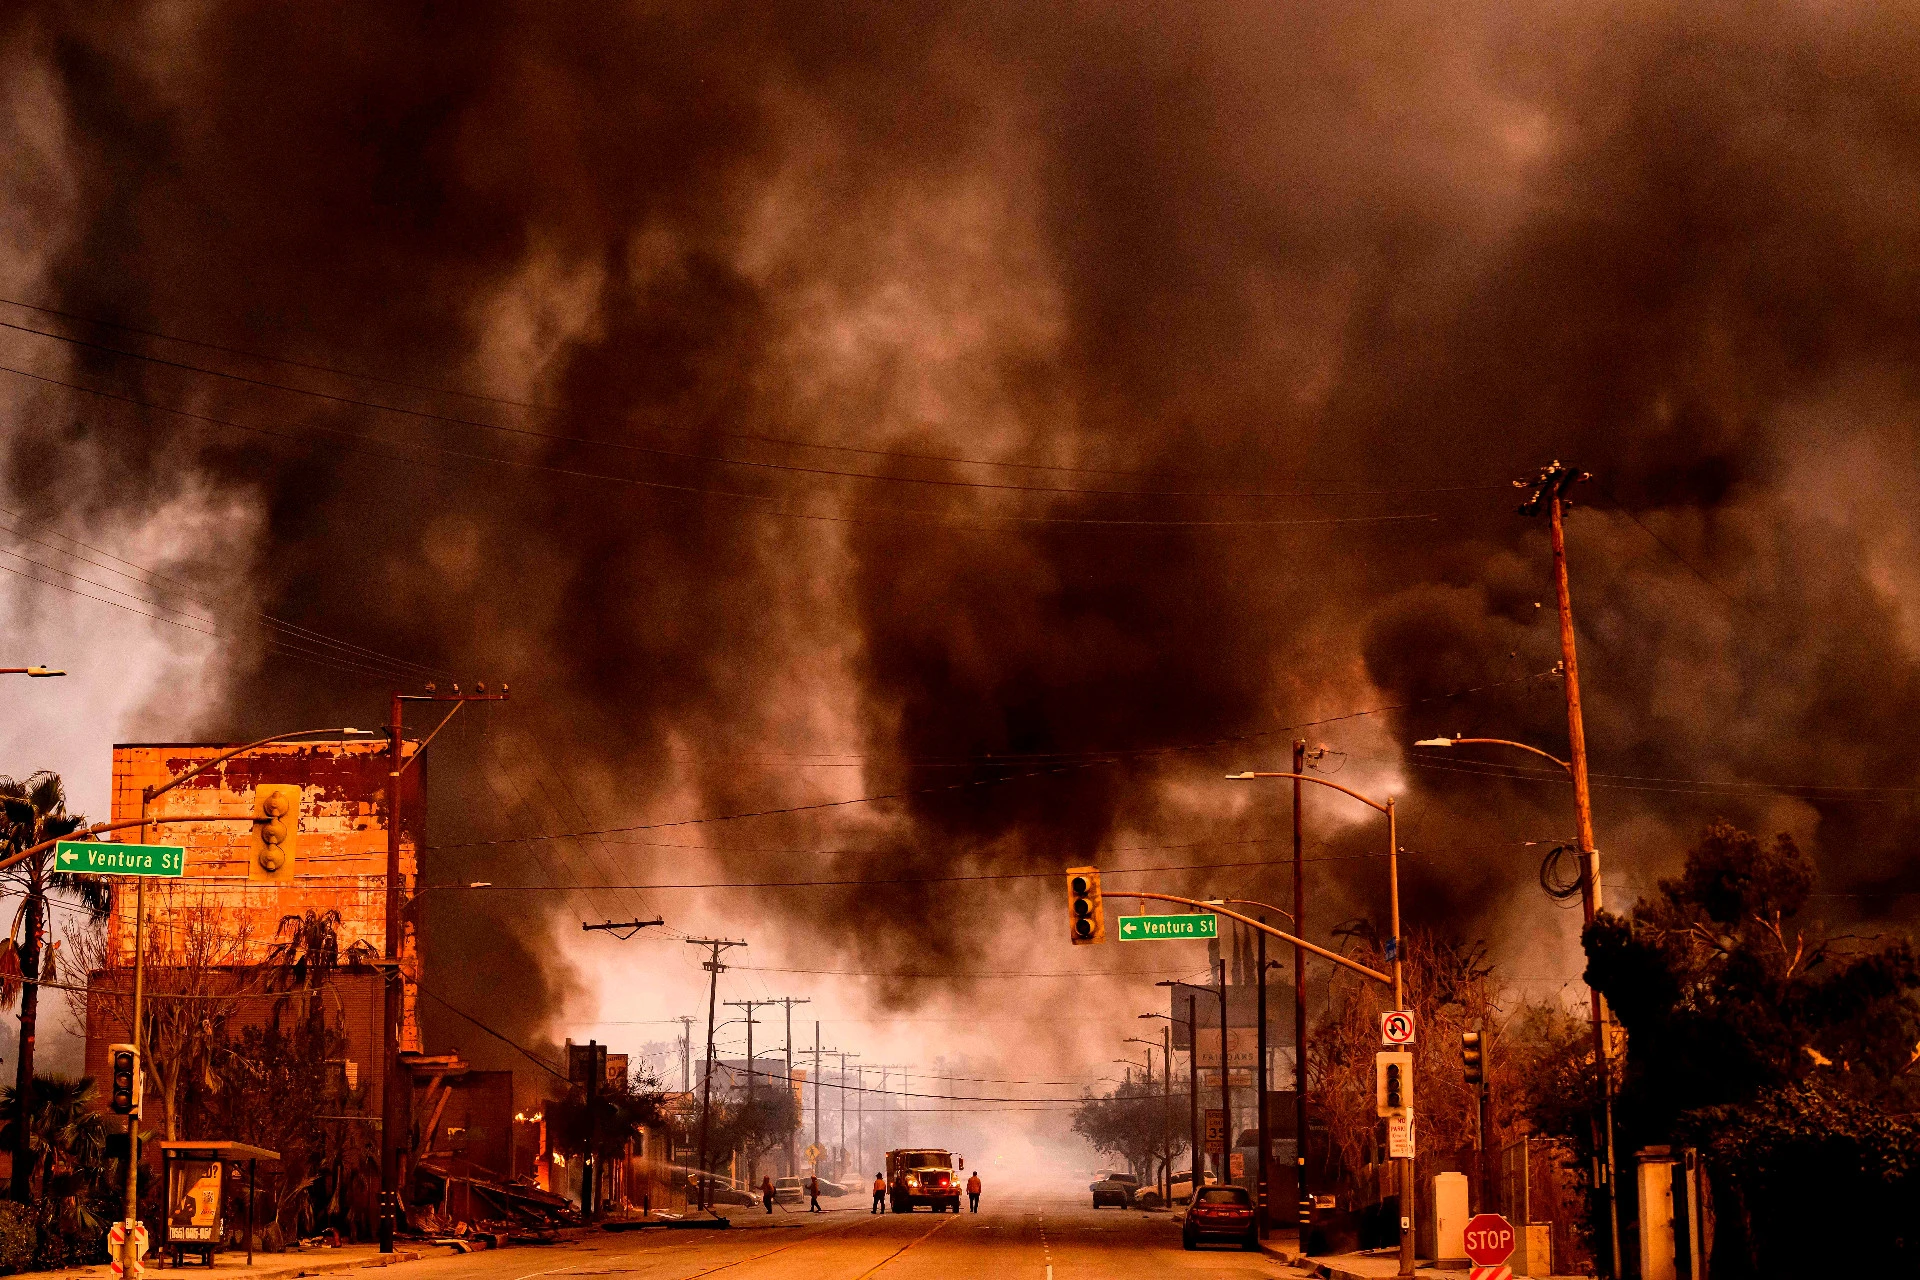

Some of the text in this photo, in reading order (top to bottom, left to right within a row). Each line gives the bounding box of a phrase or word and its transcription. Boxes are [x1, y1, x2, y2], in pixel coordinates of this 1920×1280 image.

[88, 850, 180, 869] Ventura St
[1143, 919, 1214, 934] Ventura St
[1202, 1053, 1222, 1061] FAI
[1467, 1230, 1511, 1250] STOP
